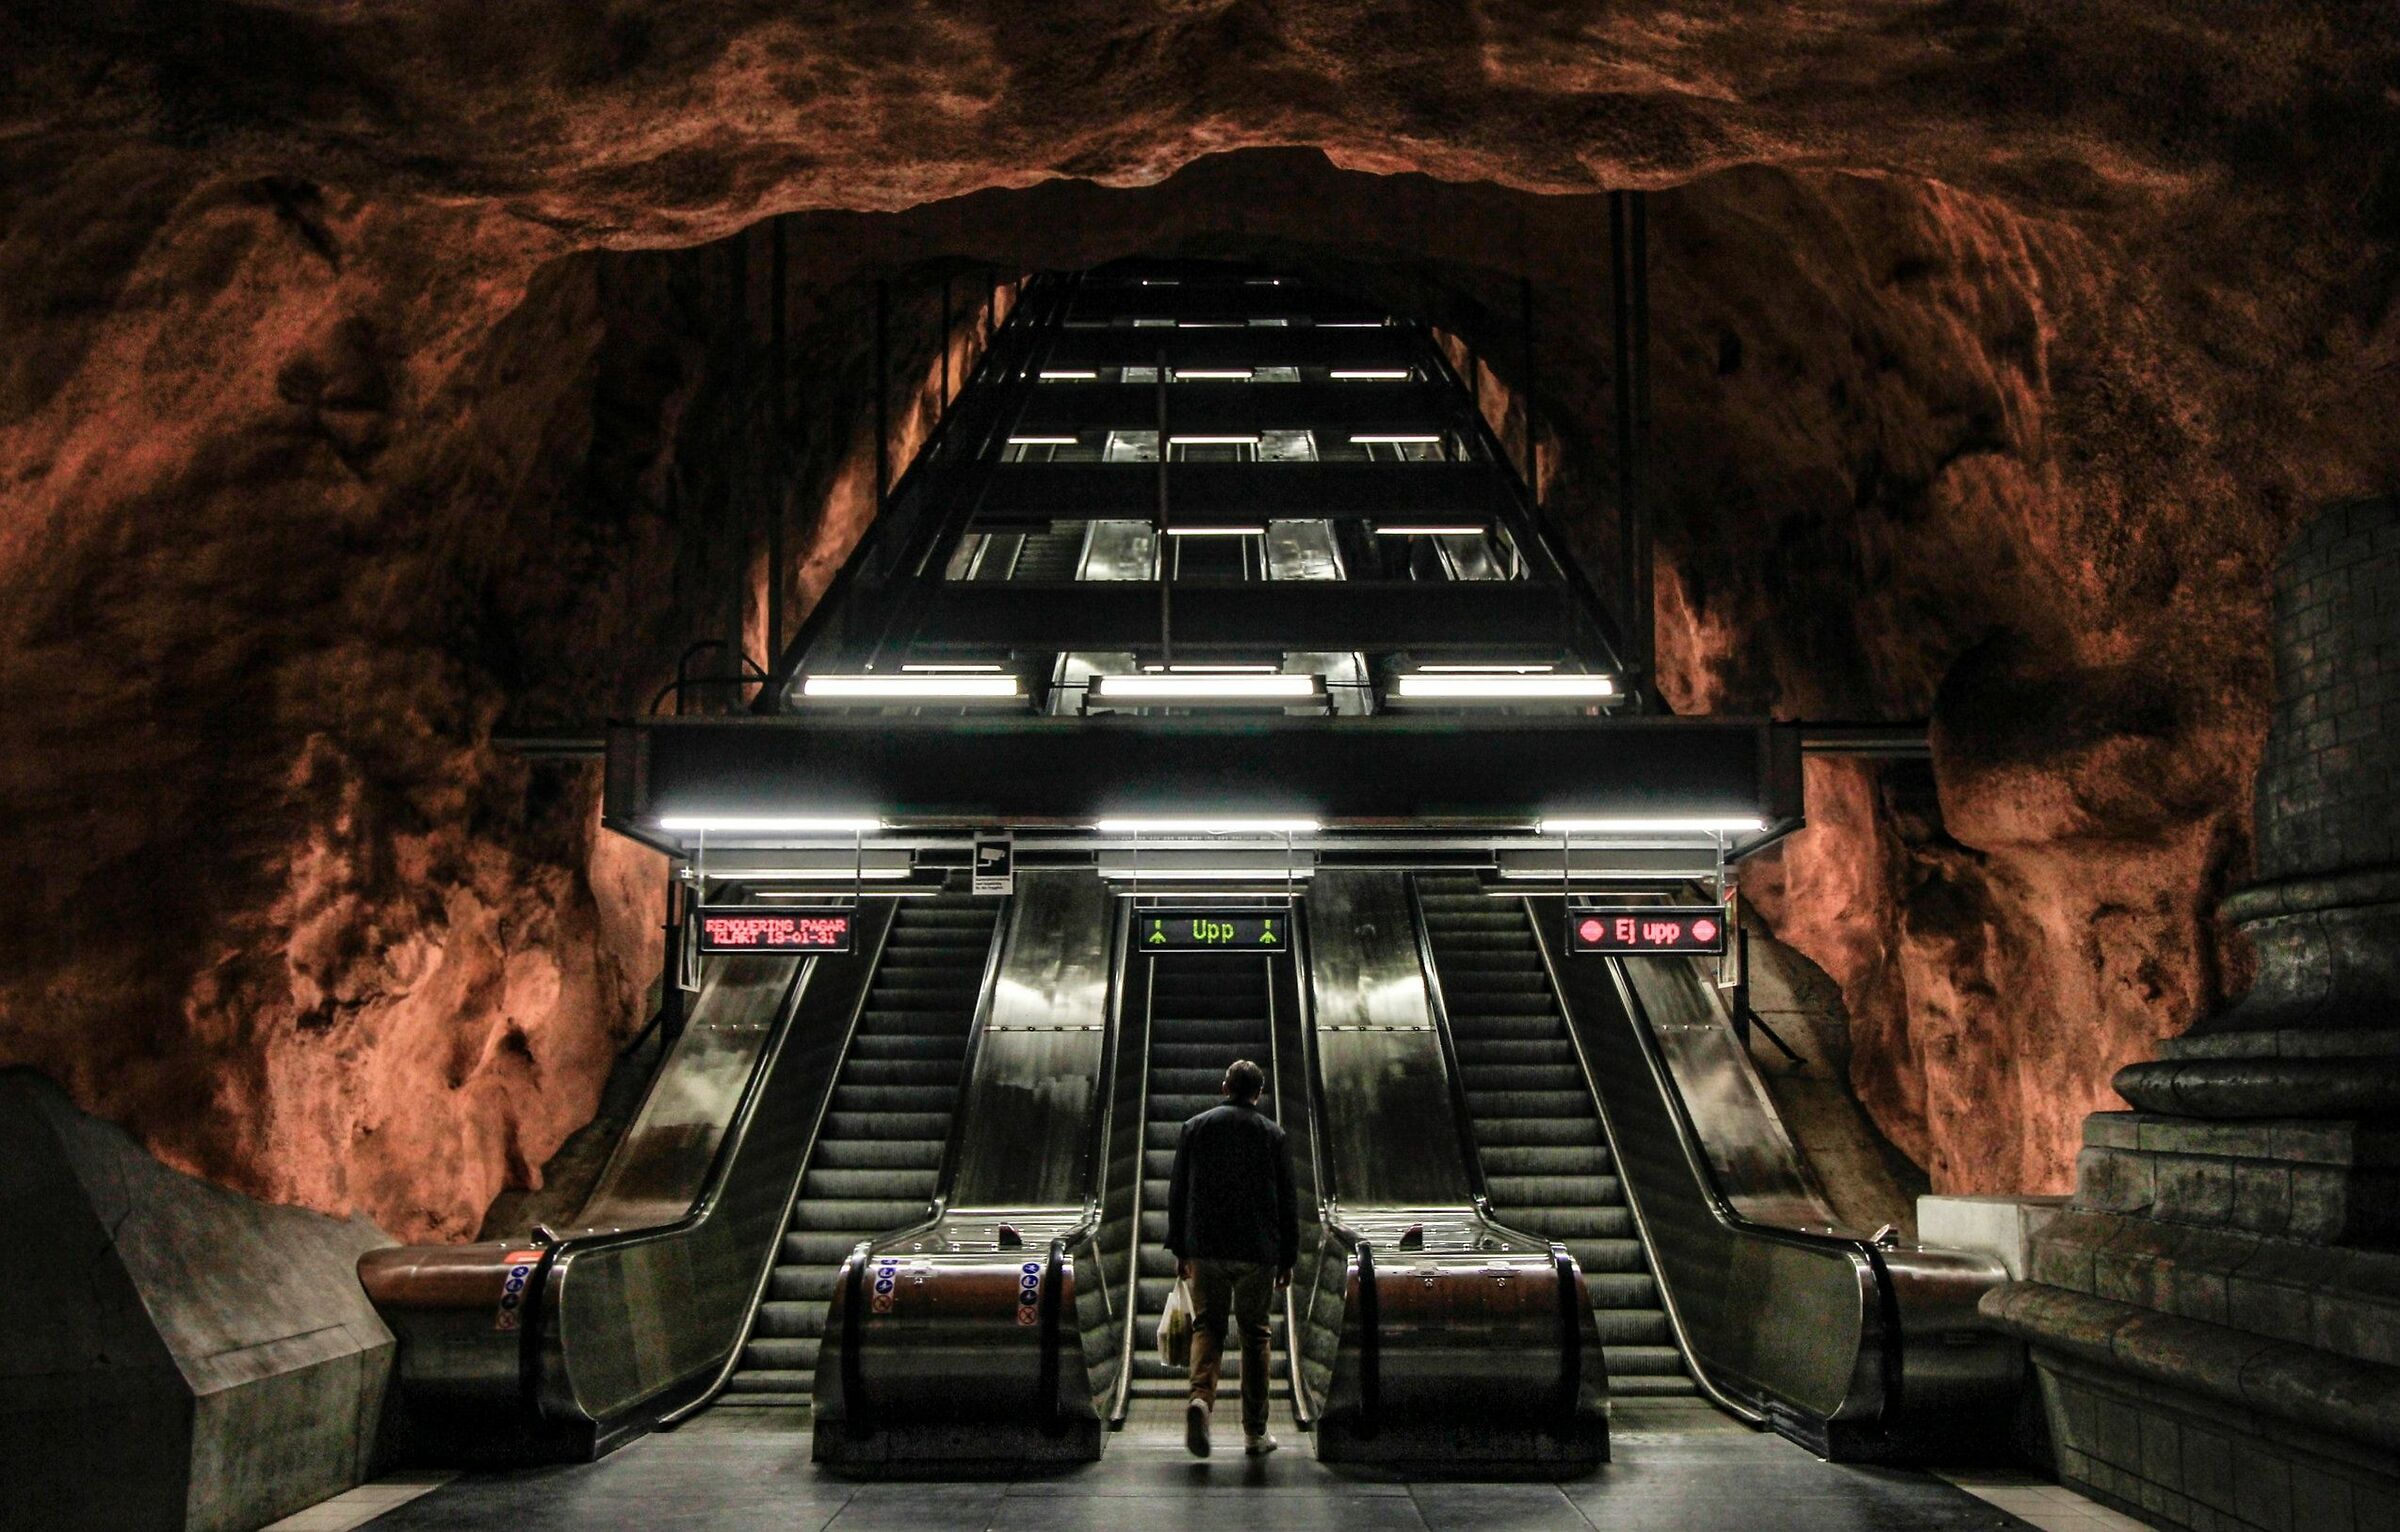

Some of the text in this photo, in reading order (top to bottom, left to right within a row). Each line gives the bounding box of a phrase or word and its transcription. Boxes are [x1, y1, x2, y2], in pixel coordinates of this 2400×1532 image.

[713, 931, 760, 944] KLART
[1192, 919, 1234, 944] Upp
[1615, 919, 1680, 945] Ej upp
